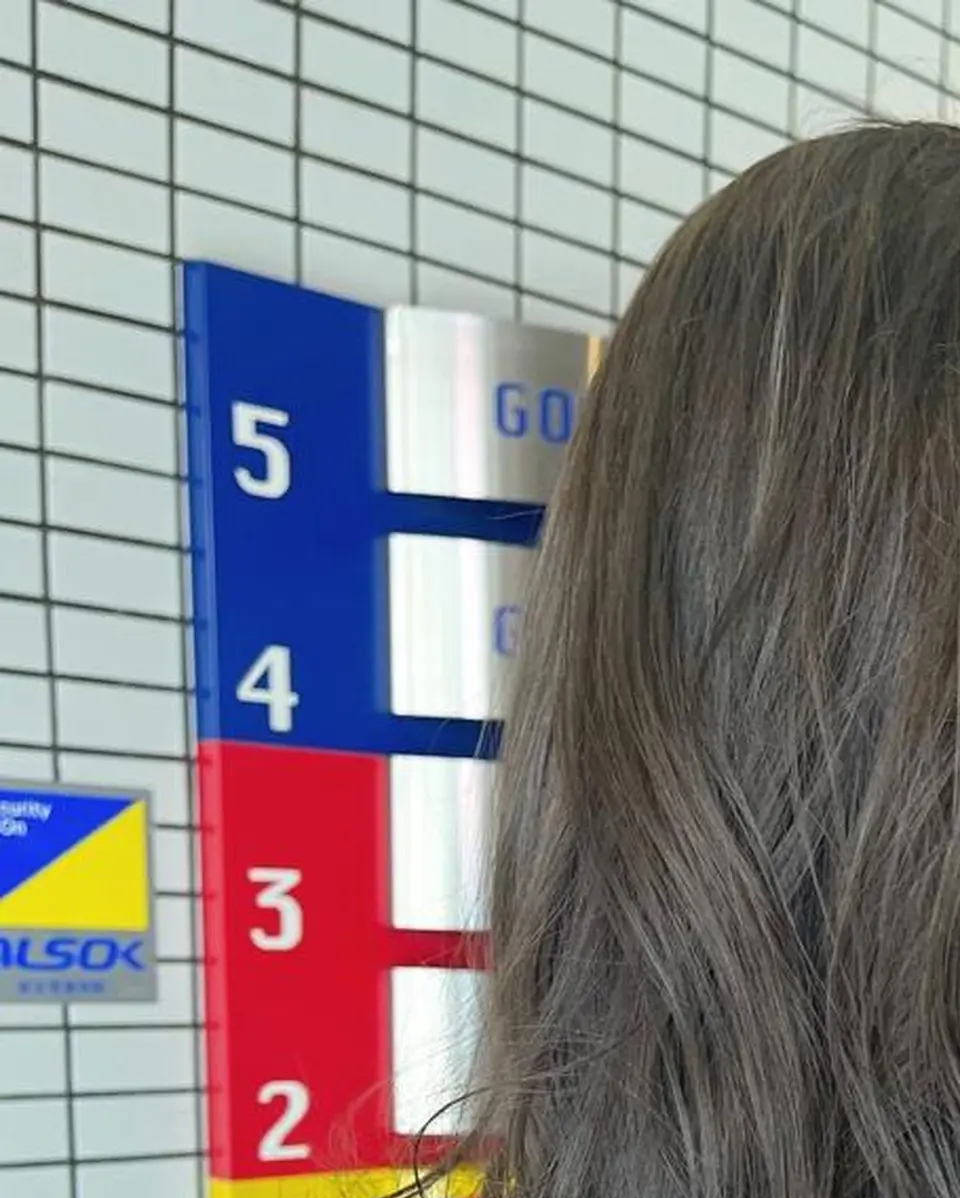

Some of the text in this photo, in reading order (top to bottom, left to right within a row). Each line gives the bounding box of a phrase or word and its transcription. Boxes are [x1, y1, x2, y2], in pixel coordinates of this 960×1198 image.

[231, 401, 291, 499] 5
[236, 645, 299, 732] 4
[247, 866, 302, 951] 3
[257, 1079, 311, 1161] 2
